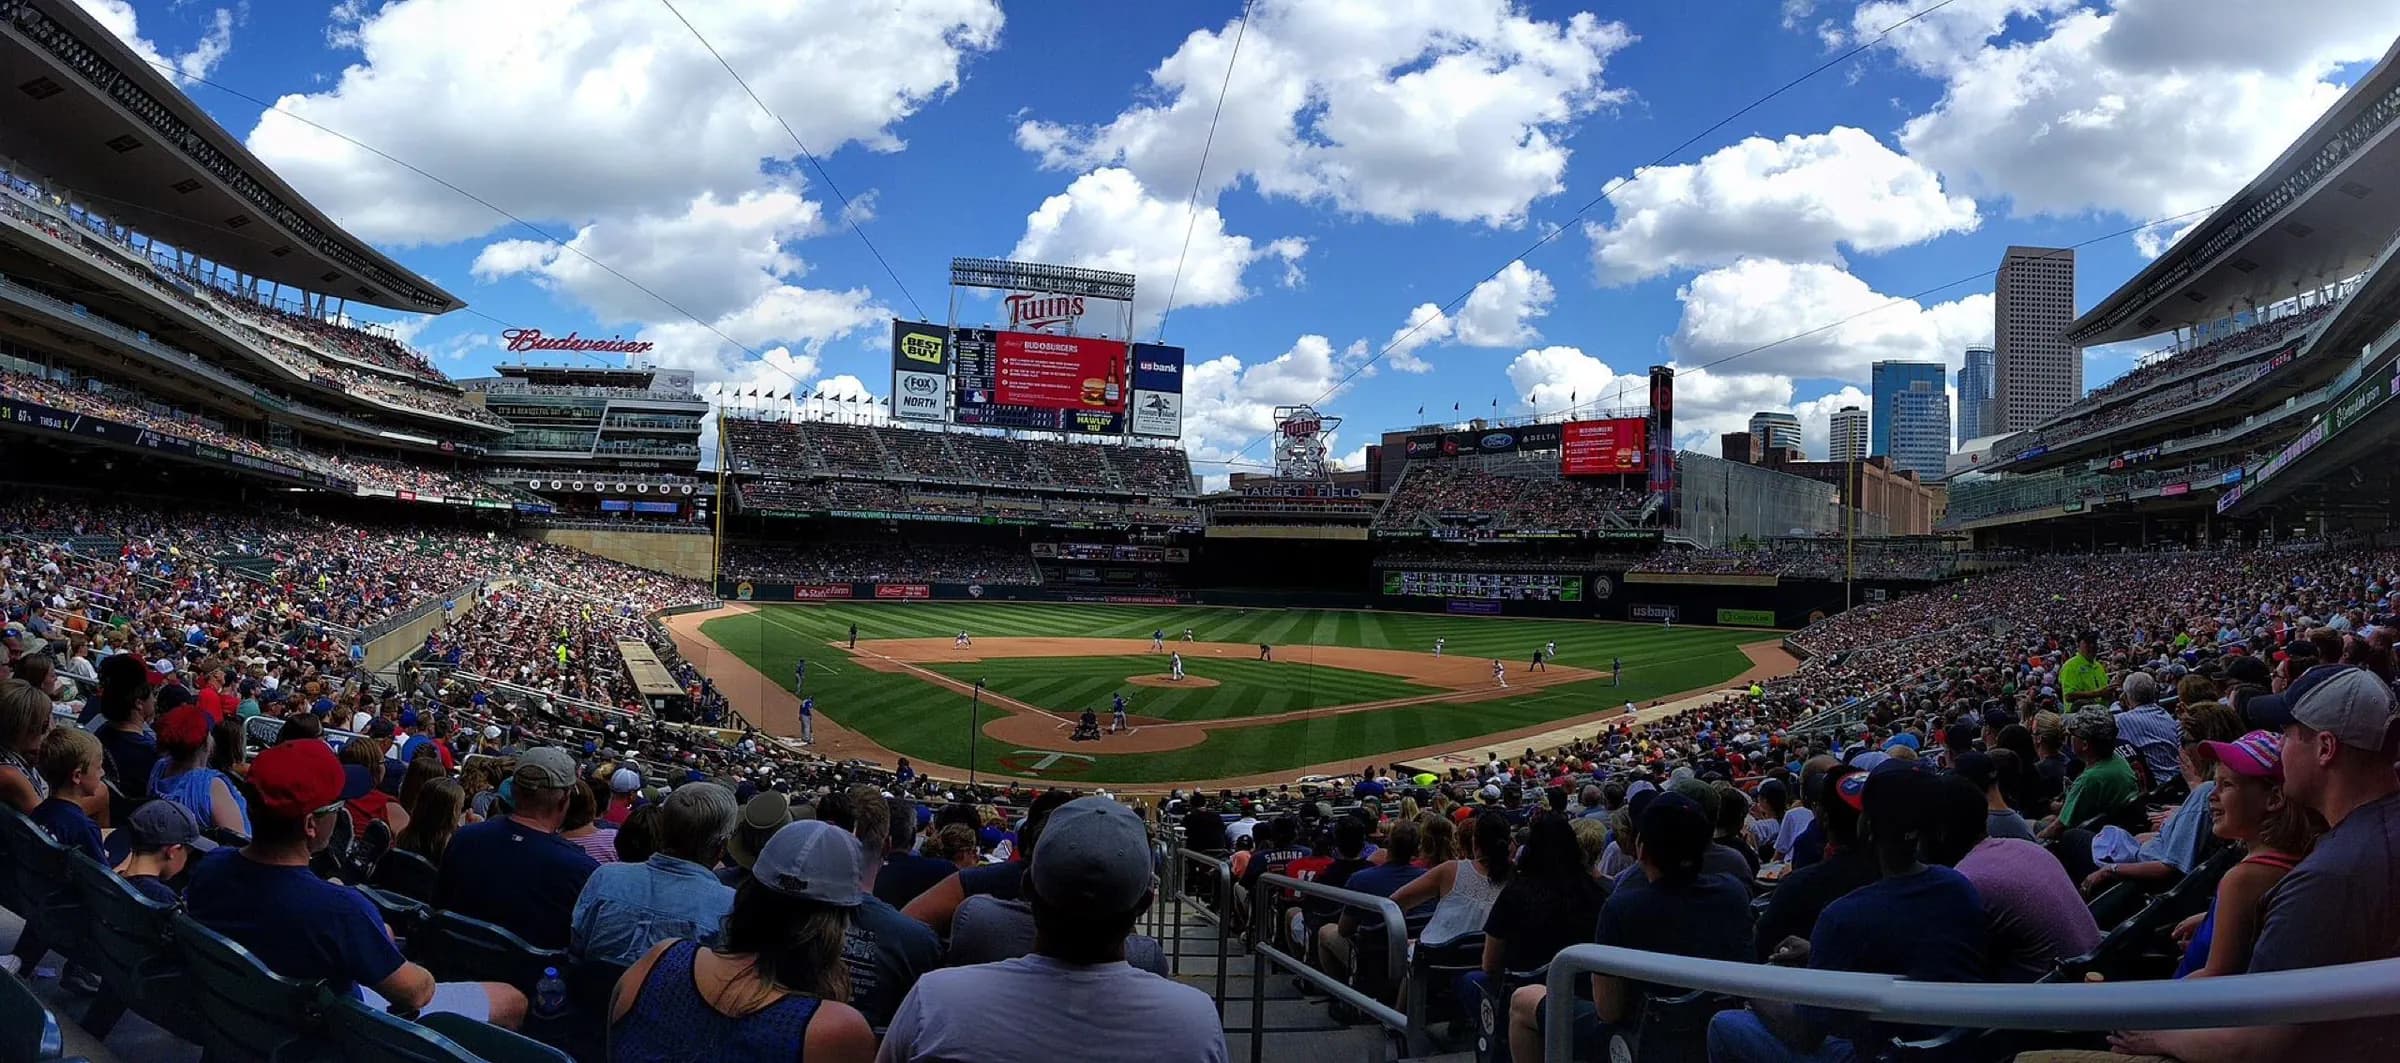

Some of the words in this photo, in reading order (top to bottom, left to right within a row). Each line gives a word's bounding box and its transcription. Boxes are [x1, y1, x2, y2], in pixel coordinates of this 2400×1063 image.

[1004, 293, 1084, 324] Twins
[502, 329, 653, 353] Budweiser
[907, 337, 941, 350] BEST
[907, 346, 937, 358] BUY
[910, 378, 931, 388] FOX
[904, 395, 937, 408] NORTH
[2, 406, 11, 419] 31
[40, 416, 53, 428] THIS
[1279, 418, 1321, 439] Twins
[1530, 433, 1556, 441] DELTA
[1417, 441, 1436, 450] pepsi
[1242, 487, 1302, 497] TARGET
[1317, 487, 1361, 497] FIELD
[1264, 850, 1303, 863] SANTANA
